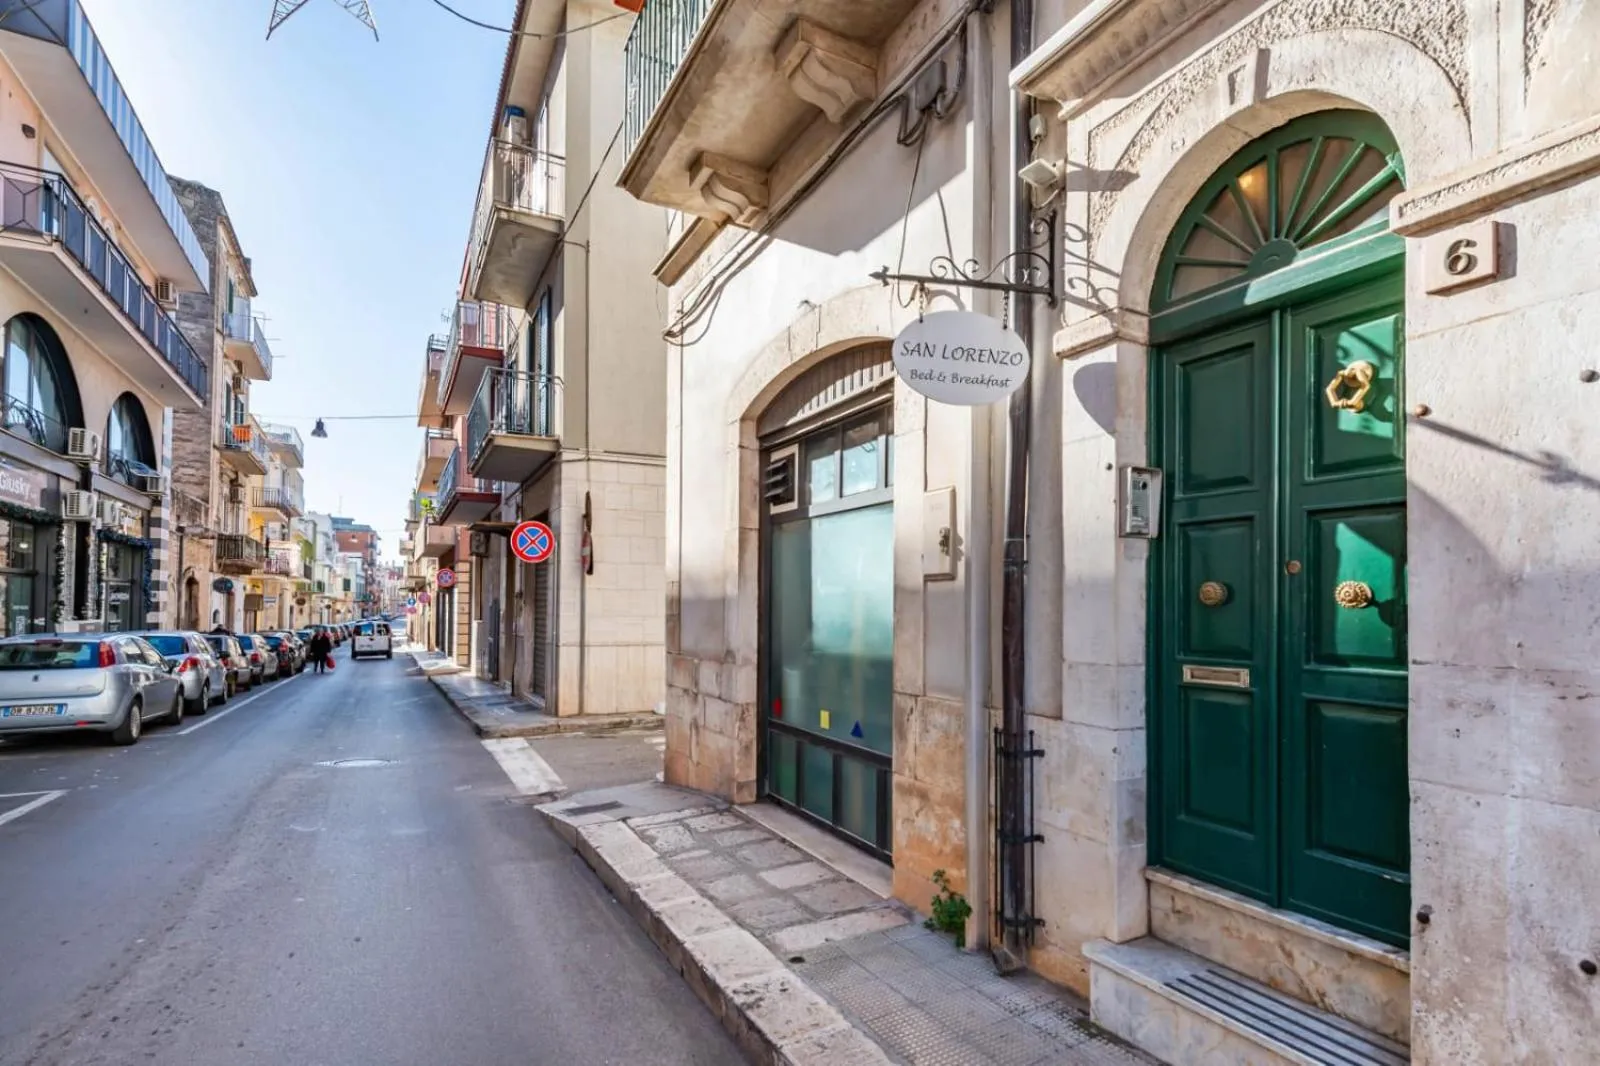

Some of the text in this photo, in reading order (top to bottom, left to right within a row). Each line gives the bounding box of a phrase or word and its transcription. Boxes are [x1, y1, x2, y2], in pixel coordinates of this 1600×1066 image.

[1444, 238, 1474, 275] 6
[901, 341, 1023, 366] SAN LORENZO
[910, 368, 1012, 389] Bed & Breakfast
